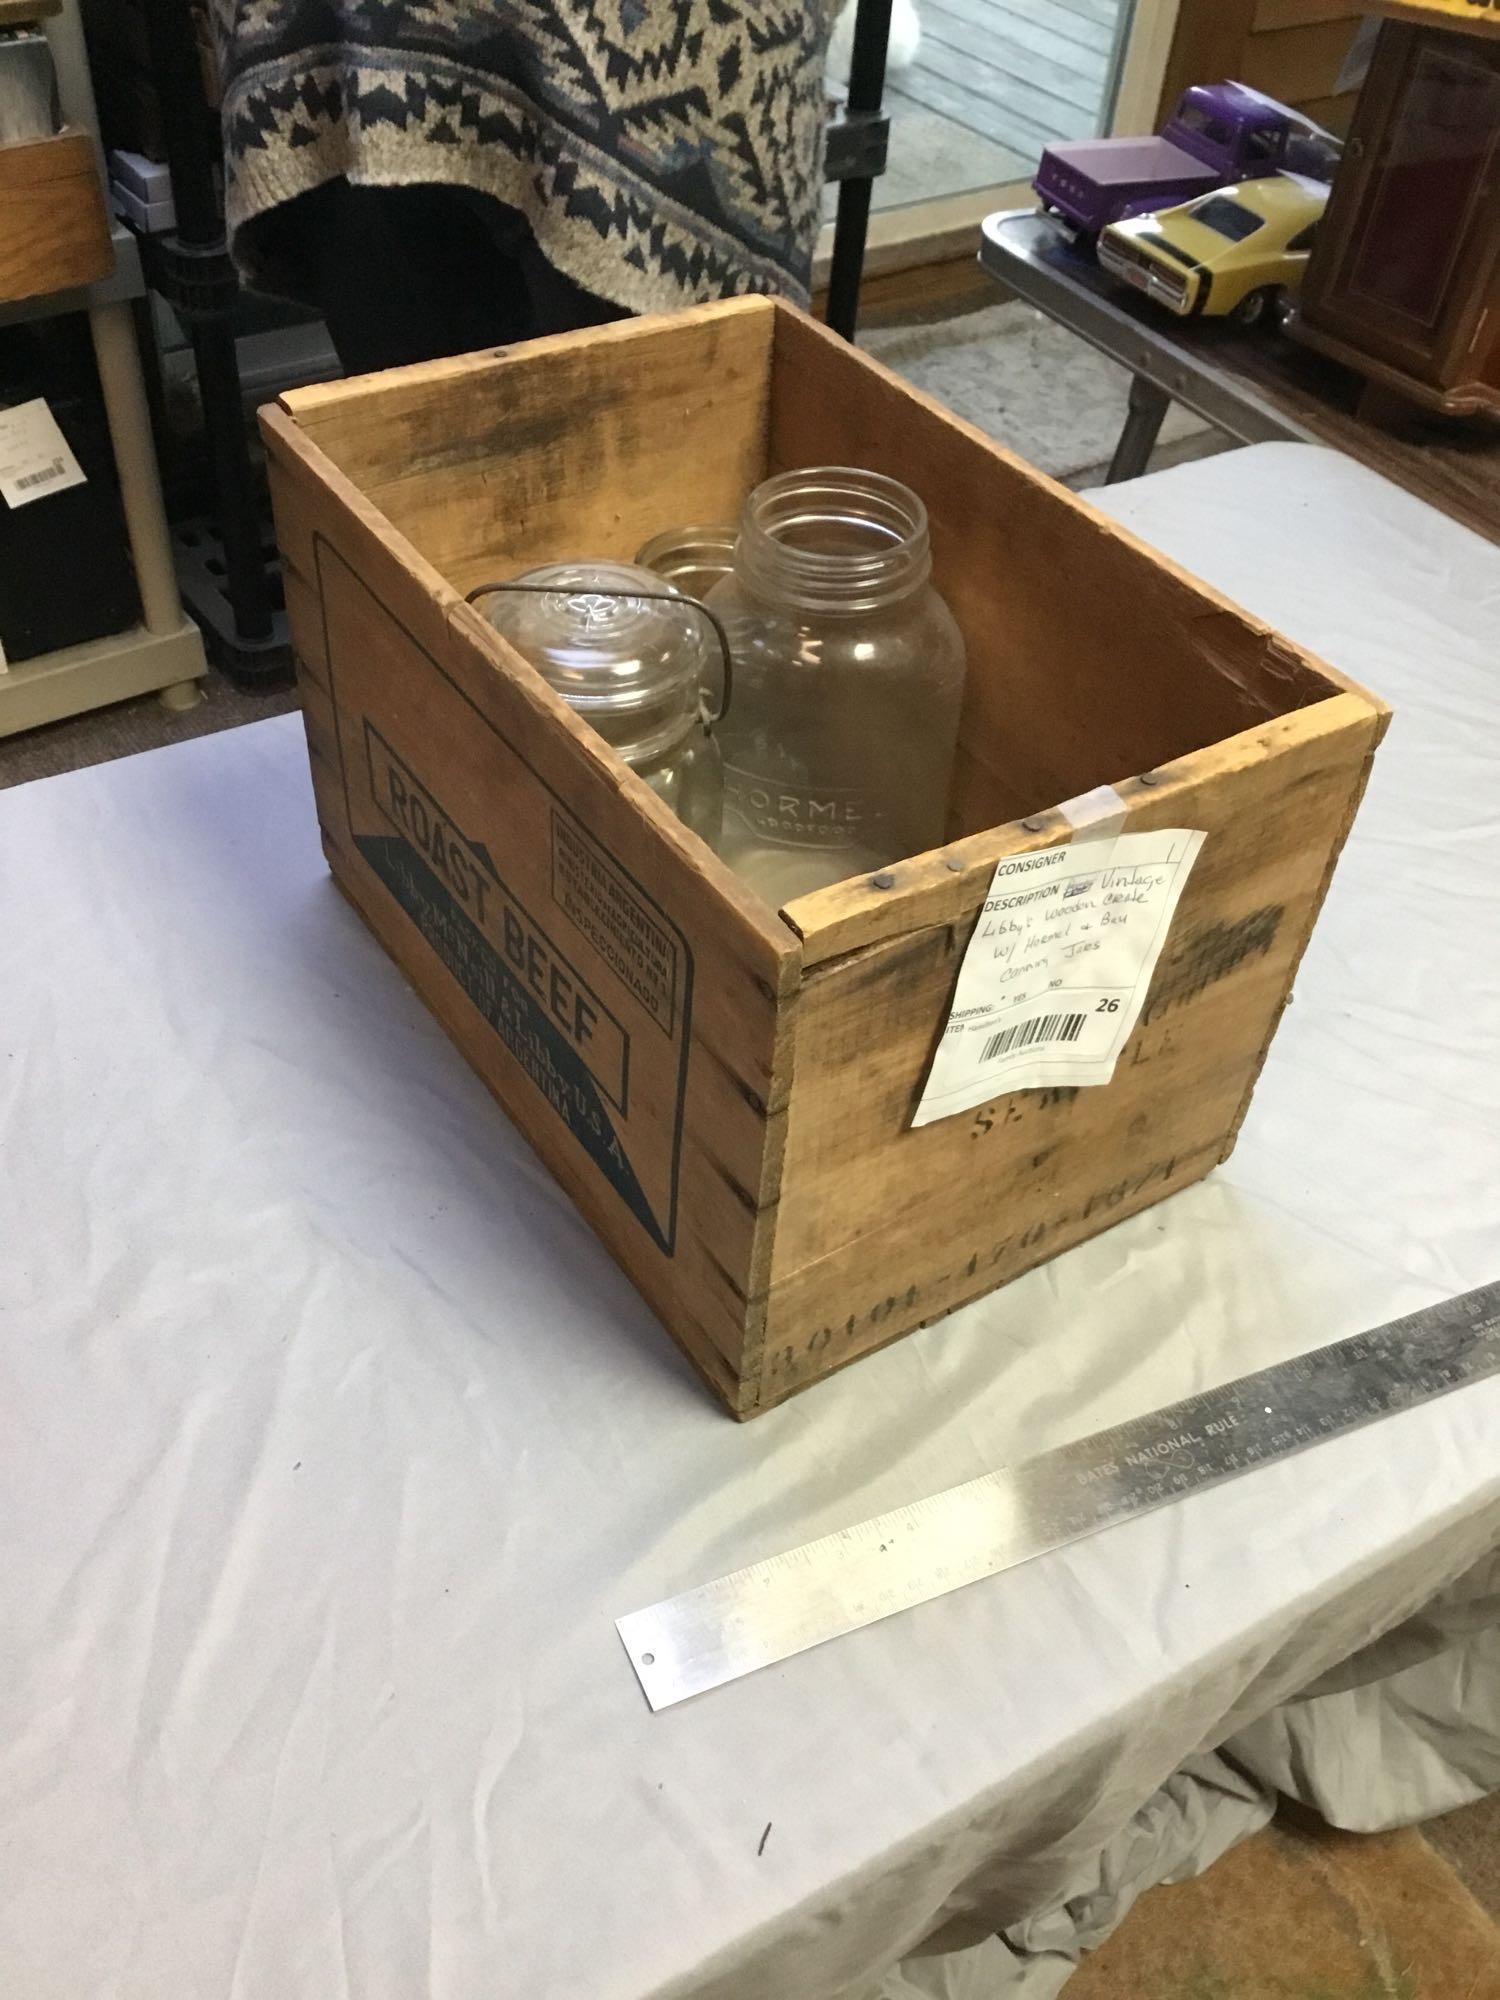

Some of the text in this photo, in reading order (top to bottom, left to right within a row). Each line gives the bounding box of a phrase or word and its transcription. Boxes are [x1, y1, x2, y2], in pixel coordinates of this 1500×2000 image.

[997, 851, 1067, 877] CONSIGNER
[388, 766, 598, 1044] ROAST BEEF
[984, 884, 1060, 913] DESCRIPTION
[1049, 979, 1063, 989] NO
[1095, 998, 1121, 1013] 26
[1125, 1431, 1201, 1466] NATIONAL
[1205, 1415, 1240, 1436] RULE
